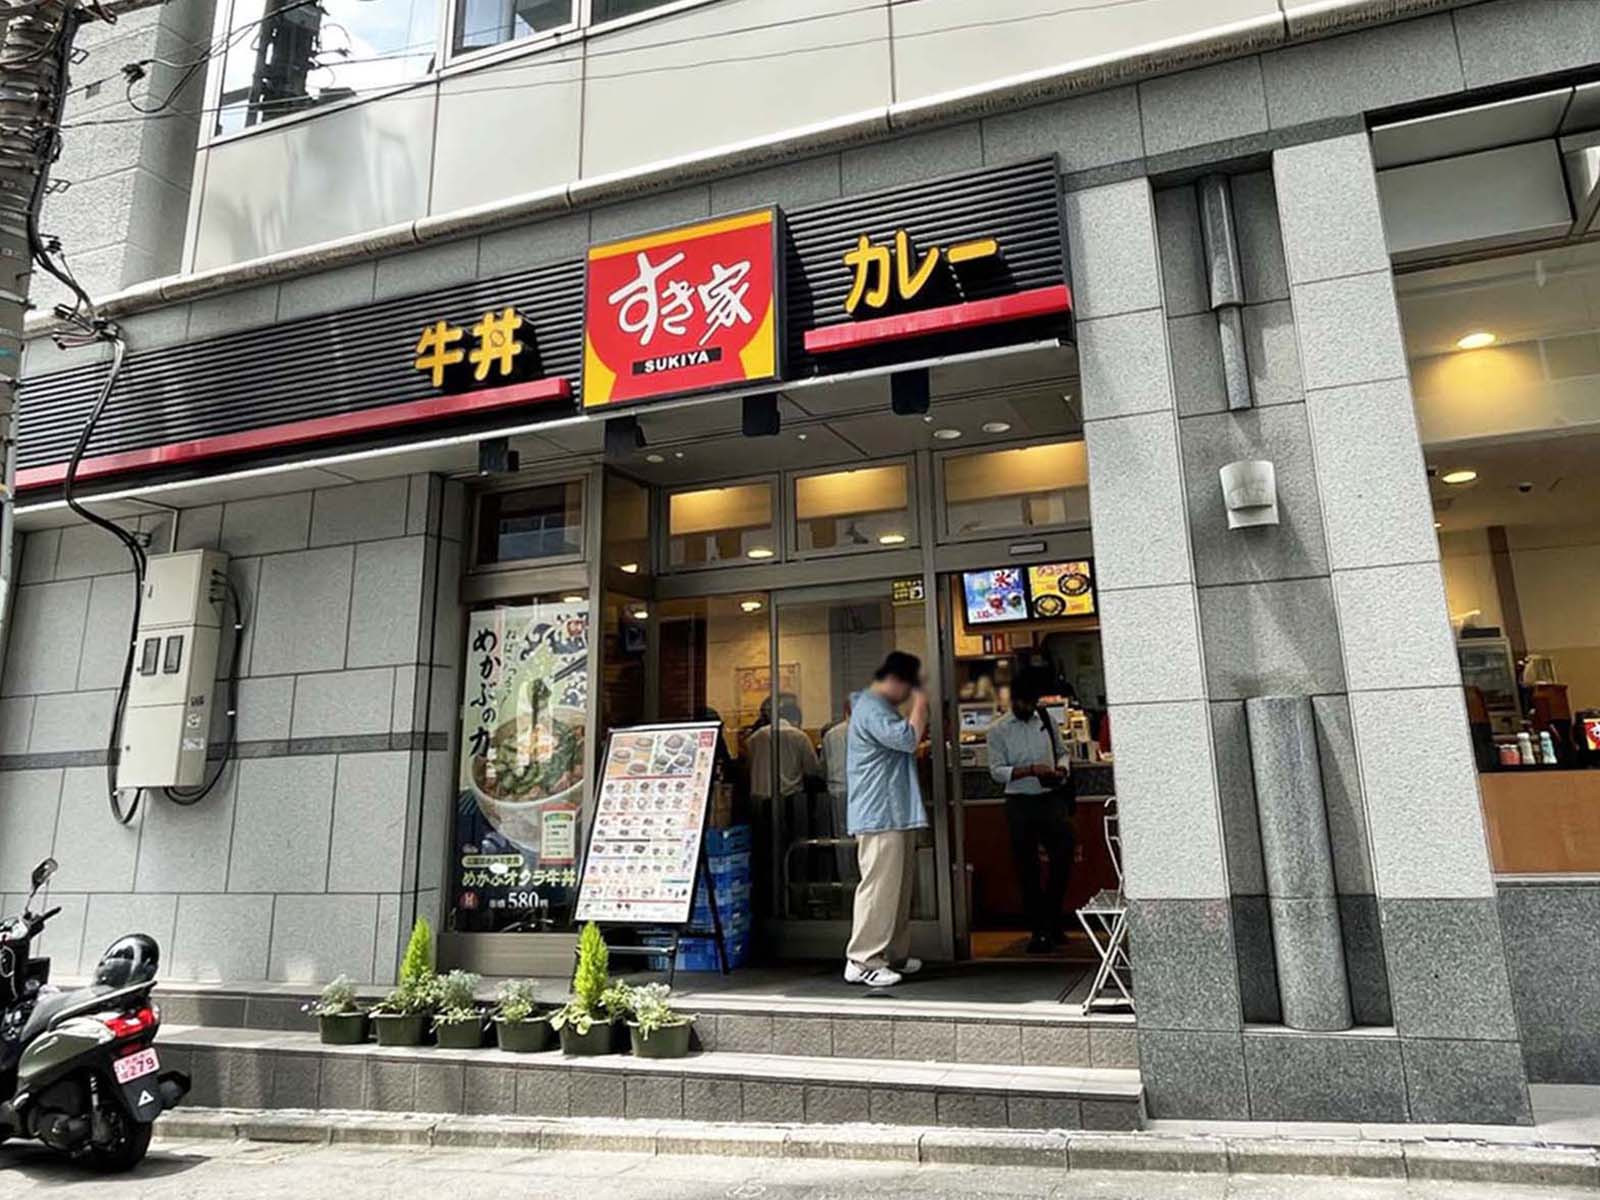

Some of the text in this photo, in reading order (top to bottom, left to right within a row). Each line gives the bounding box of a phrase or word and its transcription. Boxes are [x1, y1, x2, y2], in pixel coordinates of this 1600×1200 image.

[608, 251, 752, 346] すき家
[844, 229, 998, 313] カレー
[415, 306, 522, 387] 牛丼
[644, 350, 709, 373] SUKIYA
[469, 628, 501, 758] めかぶの力
